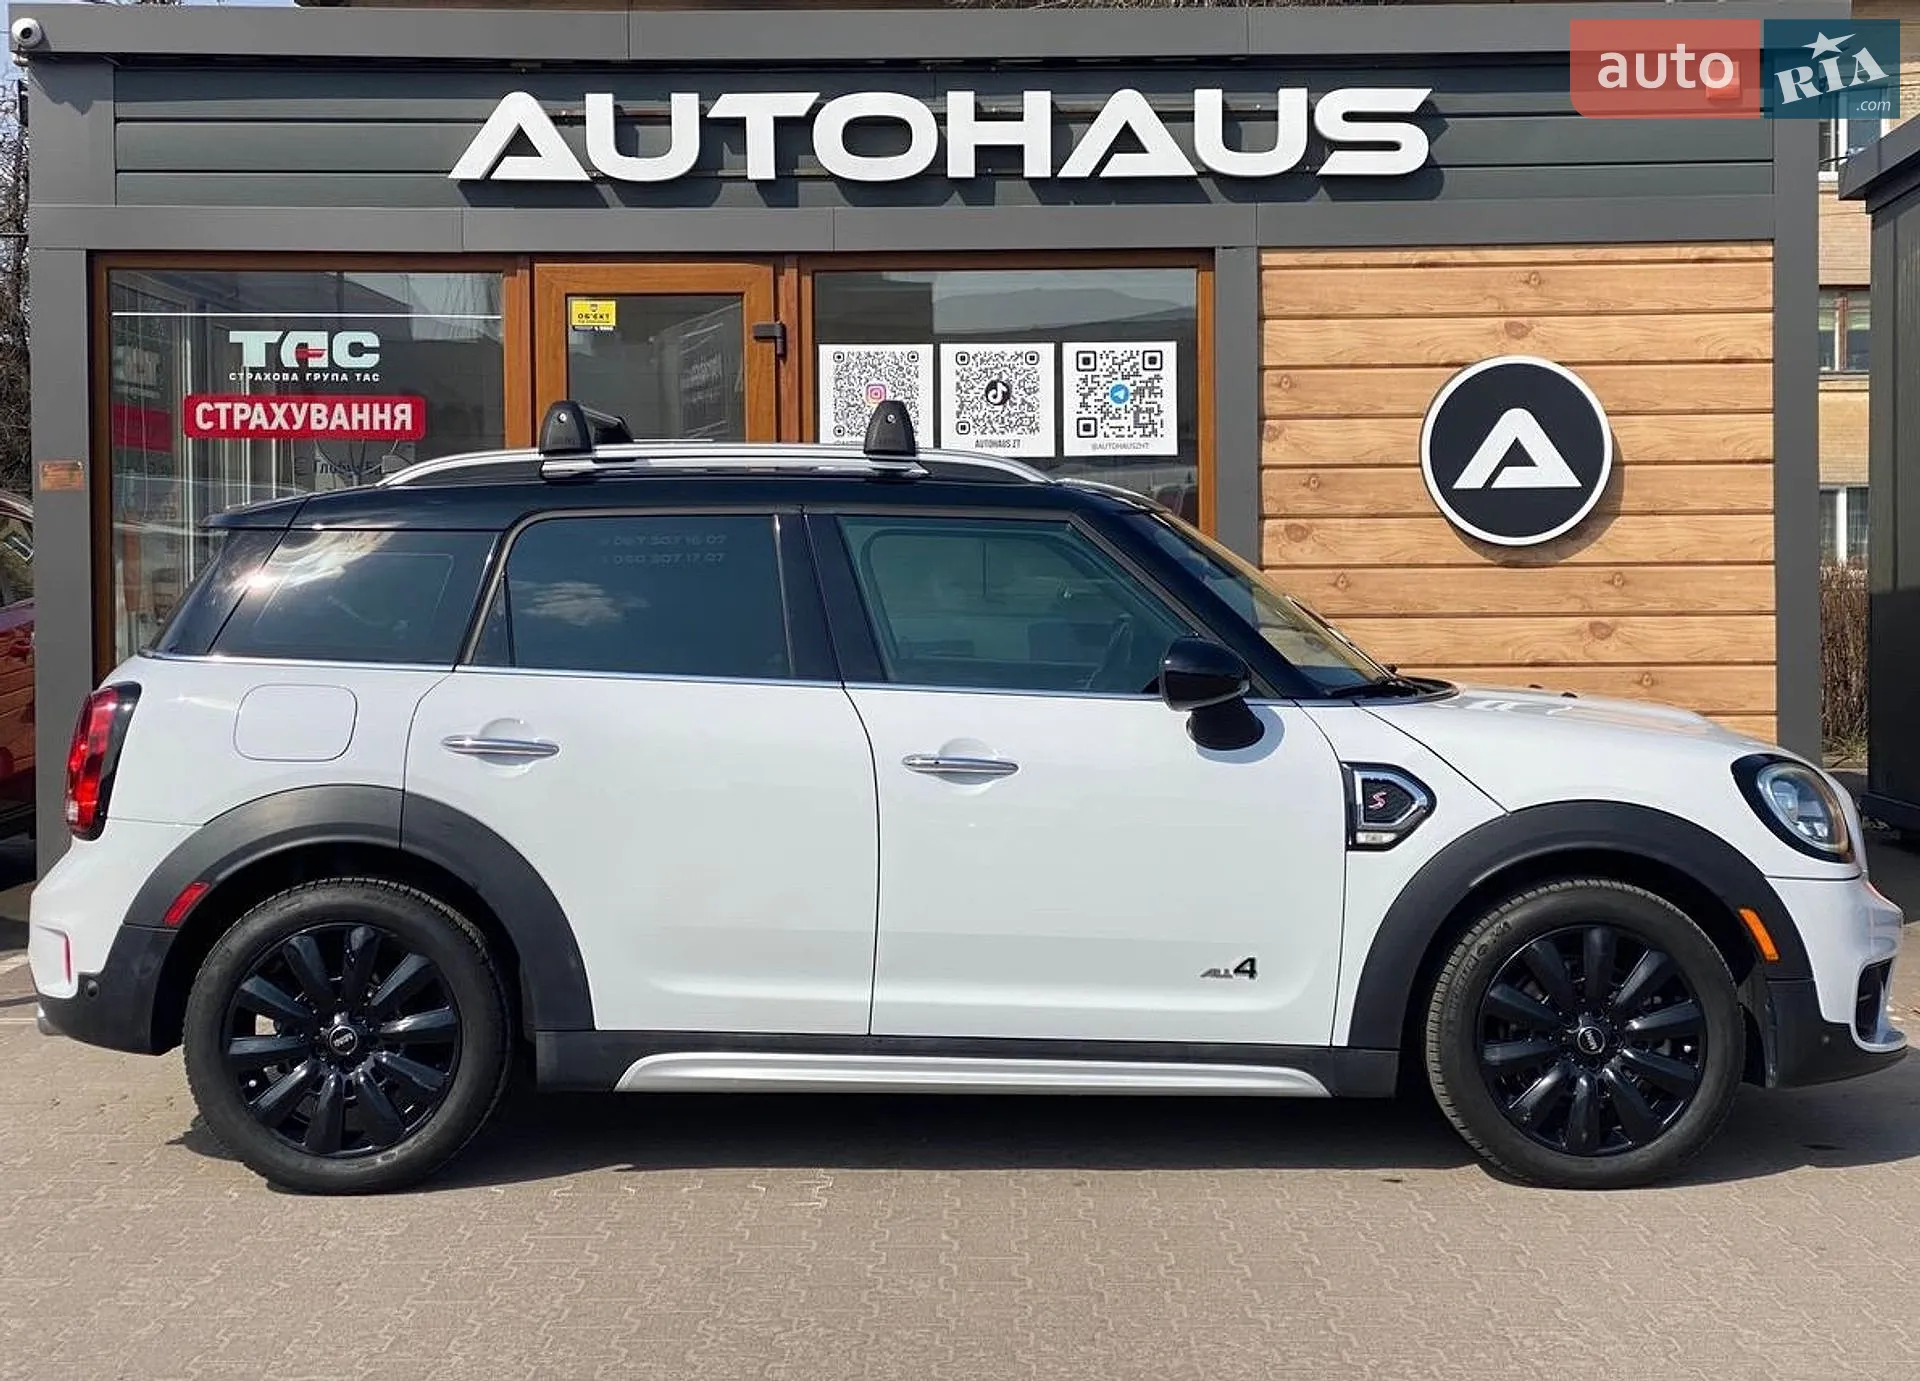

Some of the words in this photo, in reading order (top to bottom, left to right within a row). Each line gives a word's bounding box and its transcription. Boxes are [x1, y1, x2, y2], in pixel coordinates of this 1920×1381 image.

[448, 88, 1433, 182] AUTOHAUS
[229, 372, 299, 382] СТРАХОВА
[305, 372, 348, 382] ГРУПА
[355, 372, 380, 382] ТАС
[195, 403, 412, 431] СТРАХУВАННЯ
[975, 439, 1010, 448] AUTOHAUS
